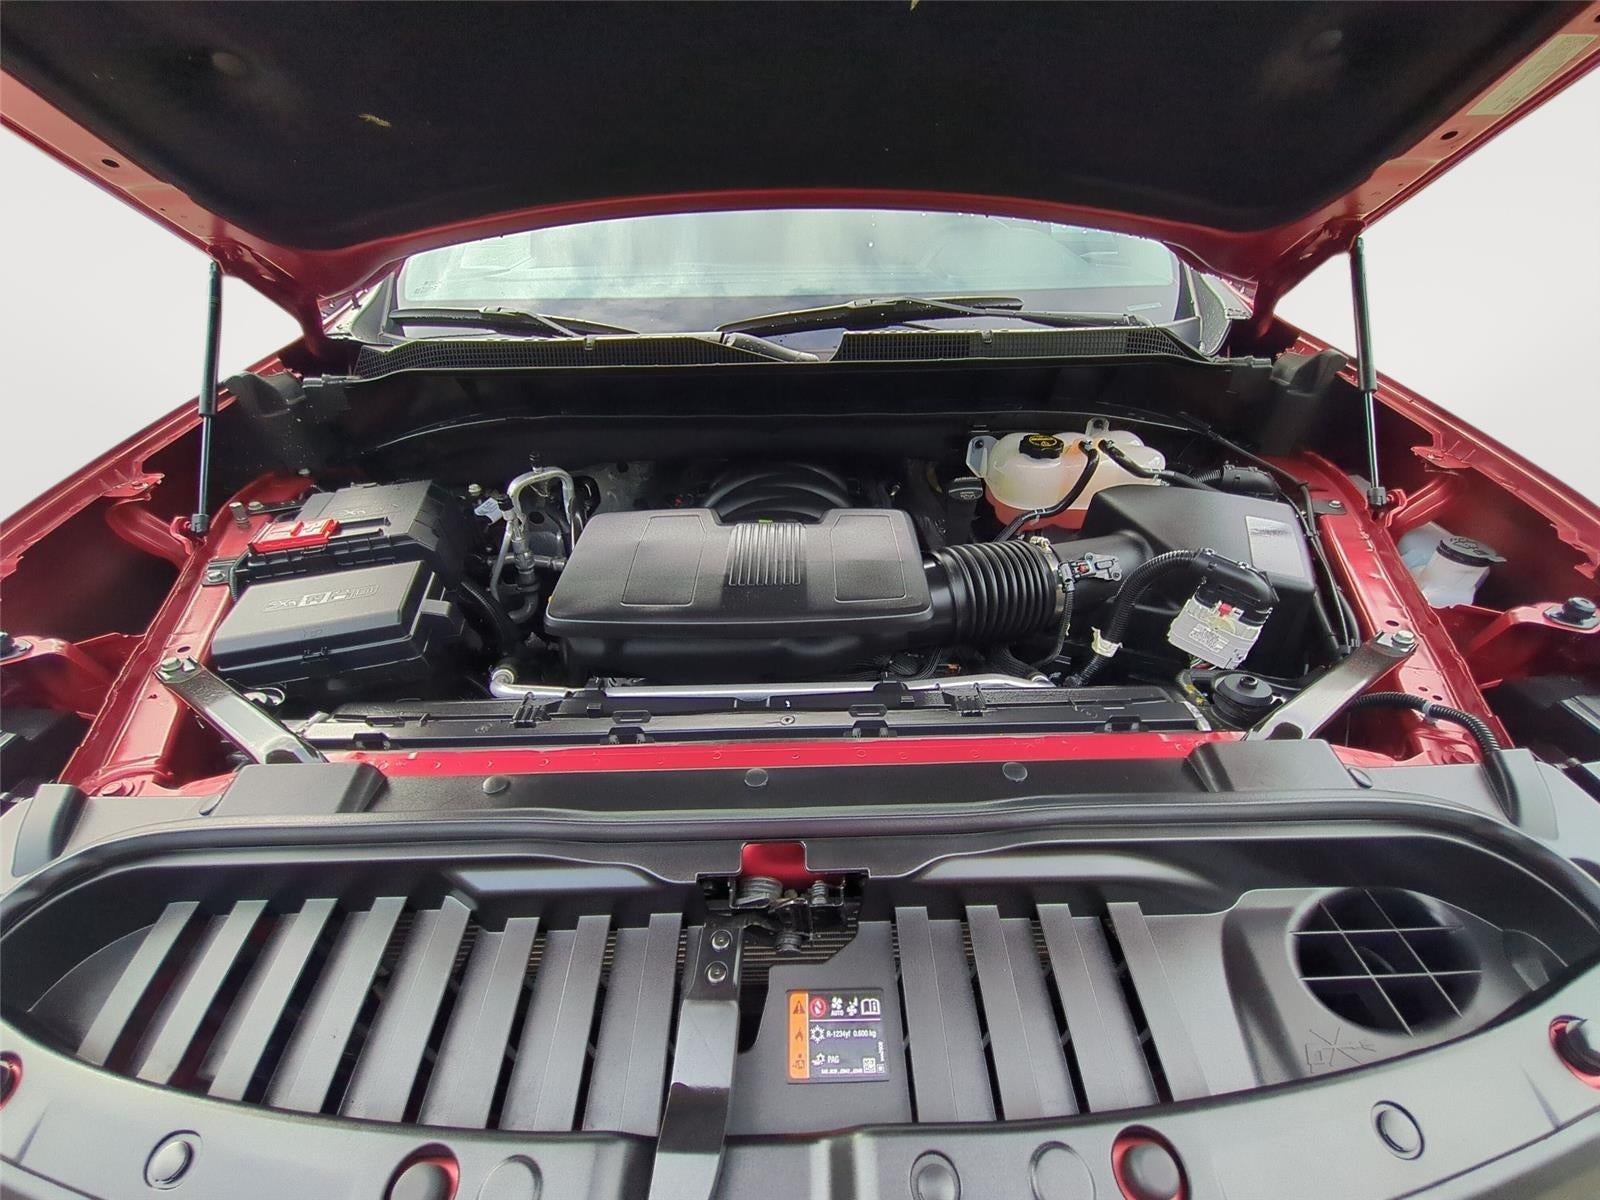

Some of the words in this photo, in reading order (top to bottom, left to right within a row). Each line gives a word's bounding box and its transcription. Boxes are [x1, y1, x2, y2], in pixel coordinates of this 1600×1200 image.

[826, 1030, 851, 1039] R-1234yf
[869, 1030, 877, 1038] kg
[827, 1055, 840, 1064] PAG
